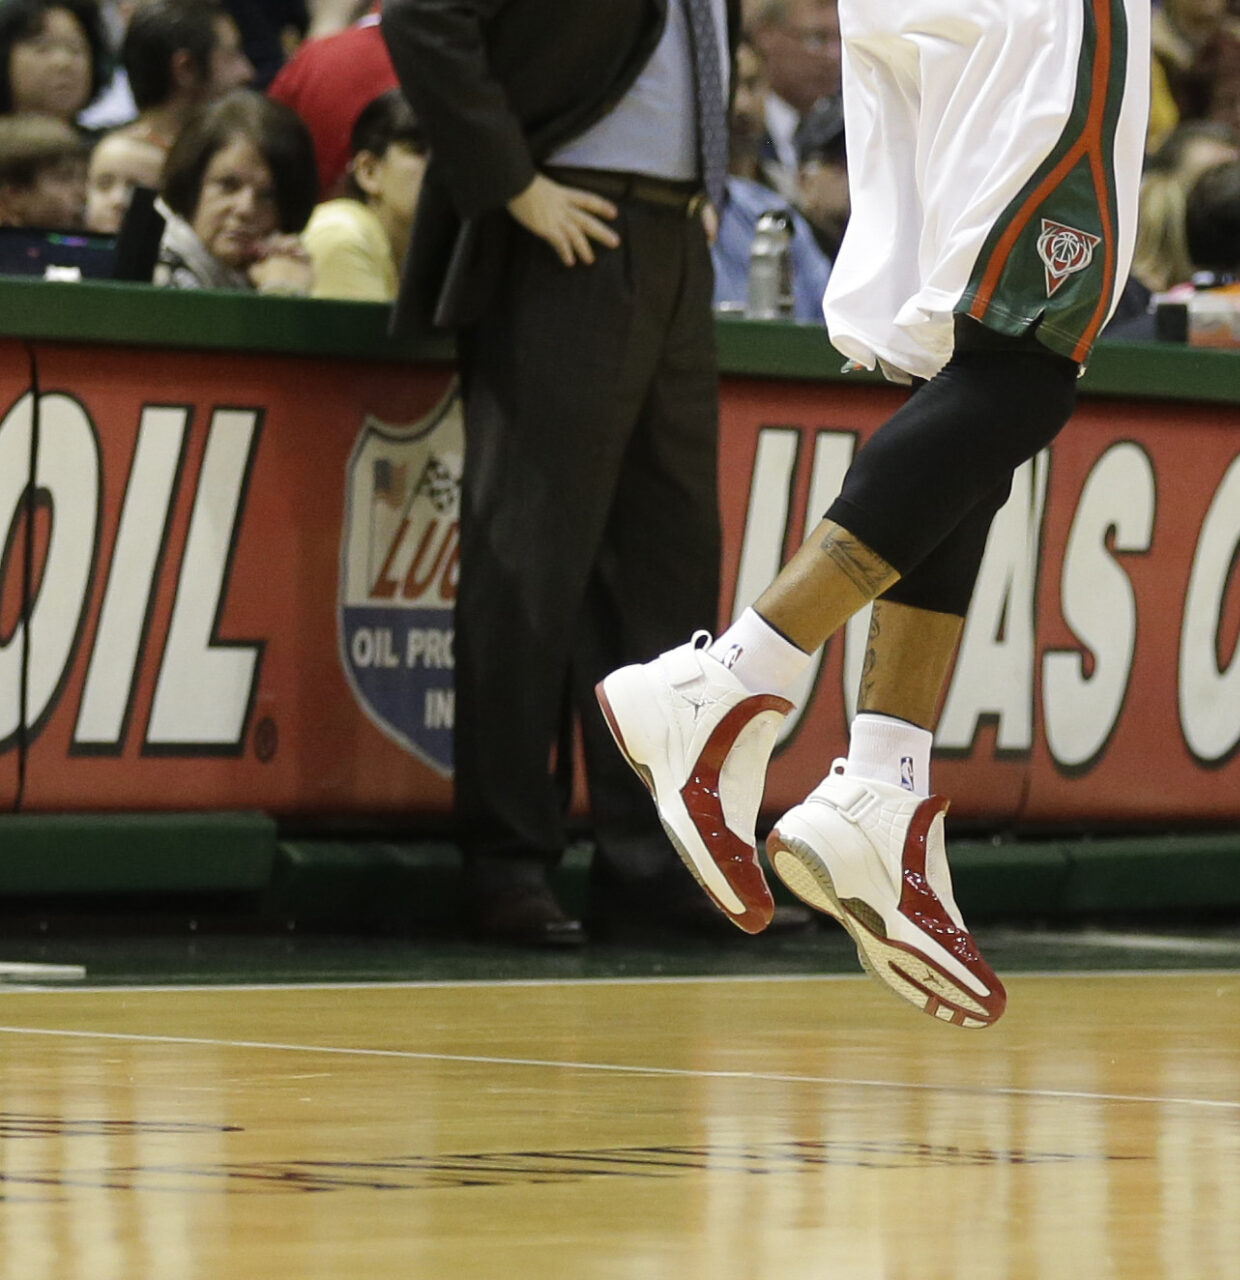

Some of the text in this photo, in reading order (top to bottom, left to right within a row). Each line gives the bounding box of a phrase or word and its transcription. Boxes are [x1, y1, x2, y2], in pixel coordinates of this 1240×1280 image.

[0, 389, 266, 758] OIL
[352, 626, 400, 669] OIL
[424, 689, 456, 730] IN
